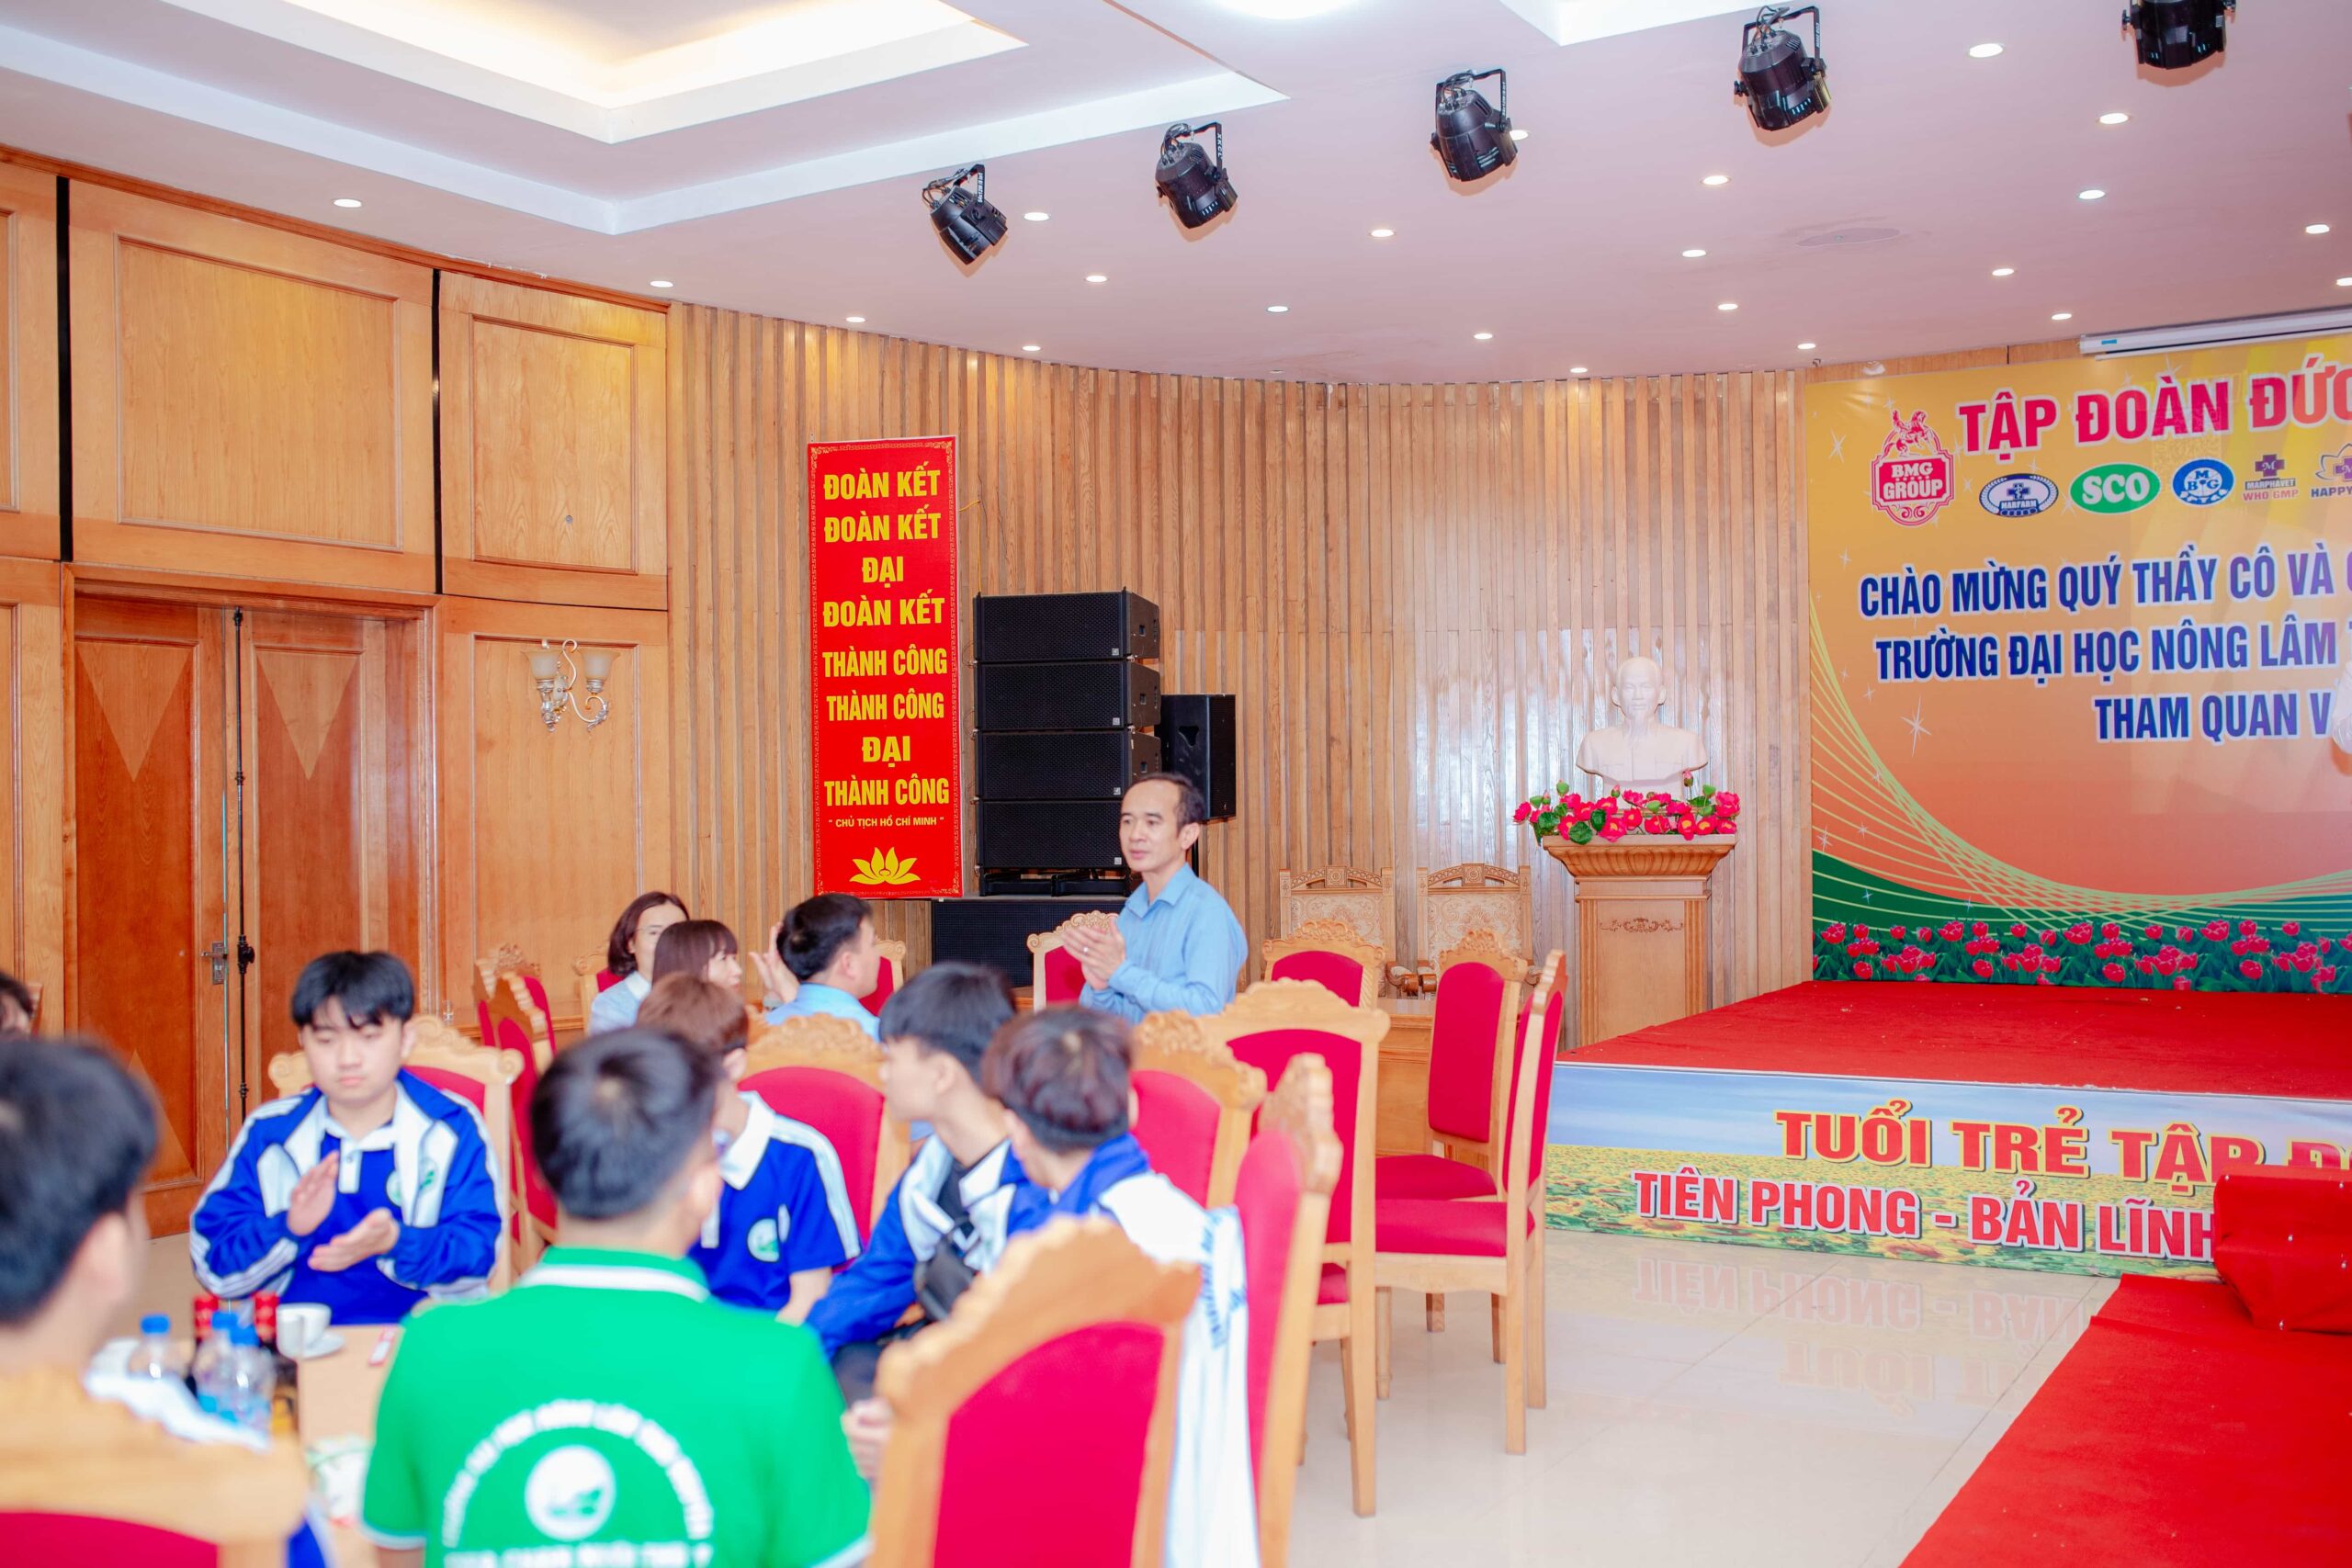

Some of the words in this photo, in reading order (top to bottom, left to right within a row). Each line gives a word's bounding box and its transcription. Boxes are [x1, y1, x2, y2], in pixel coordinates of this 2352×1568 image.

[1960, 392, 2056, 461] TẬP
[2075, 377, 2229, 442] ĐOÀN
[824, 468, 889, 500] ĐOÀN
[898, 461, 941, 497] KẾT
[1892, 462, 1933, 478] BMG
[2246, 479, 2295, 490] MARPHAVET
[1883, 479, 1943, 501] GROUP
[2081, 471, 2151, 505] SCO
[2243, 491, 2269, 501] WHO
[2273, 489, 2299, 499] GMP
[824, 511, 890, 542] ĐOÀN
[898, 504, 942, 539] KẾT
[862, 556, 904, 588] ĐẠI
[1860, 567, 1941, 616] CHÀO
[1952, 560, 2048, 612] MỪNG
[2058, 555, 2122, 612] QUÝ
[2132, 545, 2218, 603] THẦY
[2230, 546, 2276, 599] CÔ
[2287, 543, 2335, 596] VÀ
[823, 595, 891, 627] ĐOÀN
[899, 589, 945, 625] KẾT
[822, 646, 888, 678] THÀNH
[893, 644, 947, 676] CÔNG
[1875, 627, 1998, 680] TRƯỜNG
[2008, 633, 2063, 683] ĐẠI
[2074, 630, 2140, 682] HỌC
[2151, 619, 2248, 671] NÔNG
[2260, 615, 2336, 667] LÂM
[827, 690, 888, 721] THÀNH
[894, 688, 944, 720] CÔNG
[2095, 696, 2189, 739] THAM
[2201, 693, 2298, 742] QUAN
[862, 735, 910, 768] ĐẠI
[824, 774, 889, 807] THÀNH
[895, 773, 950, 806] CÔNG
[835, 816, 855, 828] CHỦ
[856, 818, 878, 829] TỊCH
[912, 817, 937, 826] MINH
[1776, 1100, 1927, 1164] TUỔI
[1952, 1107, 2085, 1175] TRẺ
[2111, 1123, 2260, 1193] TẬP
[1634, 1167, 1734, 1221] TIÊN
[1752, 1181, 1916, 1235] PHONG
[1973, 1180, 2078, 1247] BẢN
